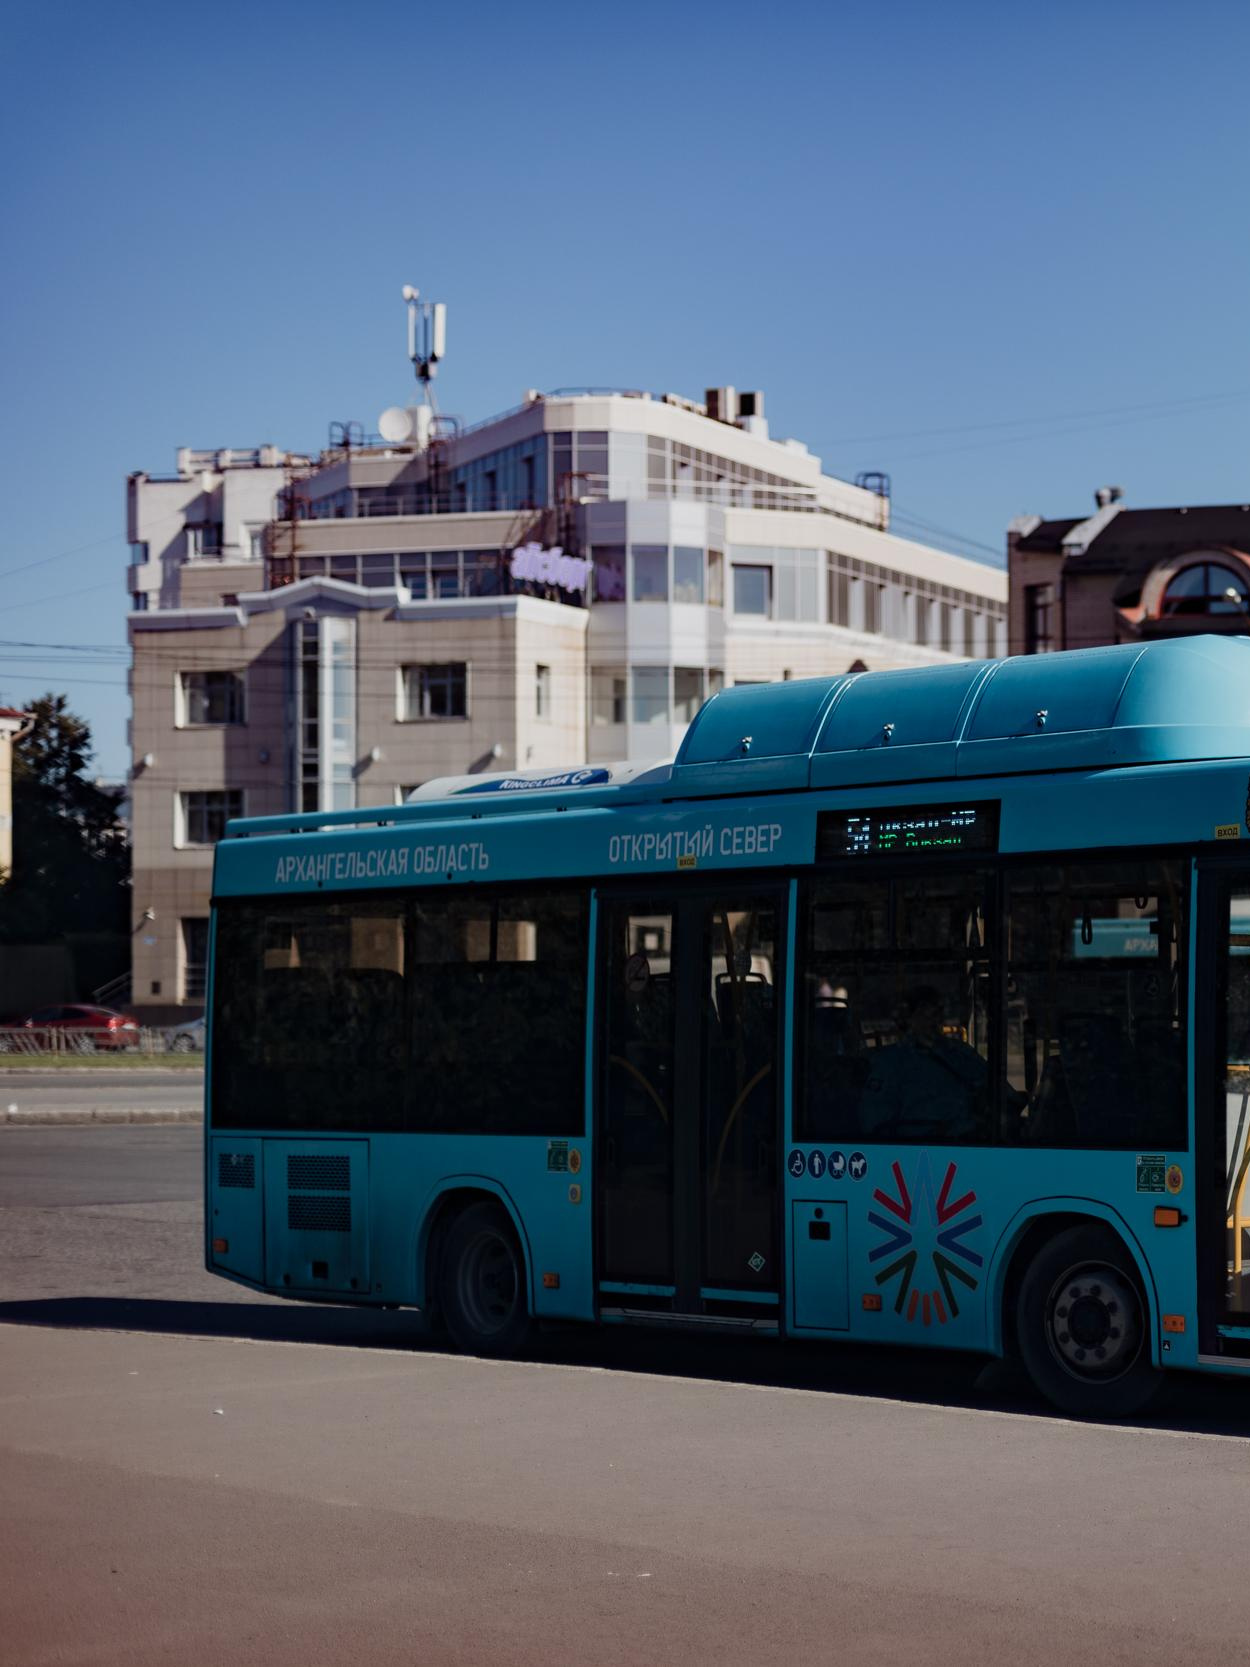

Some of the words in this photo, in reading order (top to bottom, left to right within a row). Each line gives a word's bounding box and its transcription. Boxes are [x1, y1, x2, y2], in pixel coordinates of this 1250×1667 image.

[499, 774, 570, 790] KINGCLIMA
[608, 823, 713, 863] ОТКРЫТЫЙ
[720, 822, 783, 856] СЕВЕР
[1217, 826, 1239, 837] ВХОД
[274, 846, 409, 885] АРХАНГЕЛЬСКАЯ
[413, 842, 490, 874] ОБЛАСТЬ
